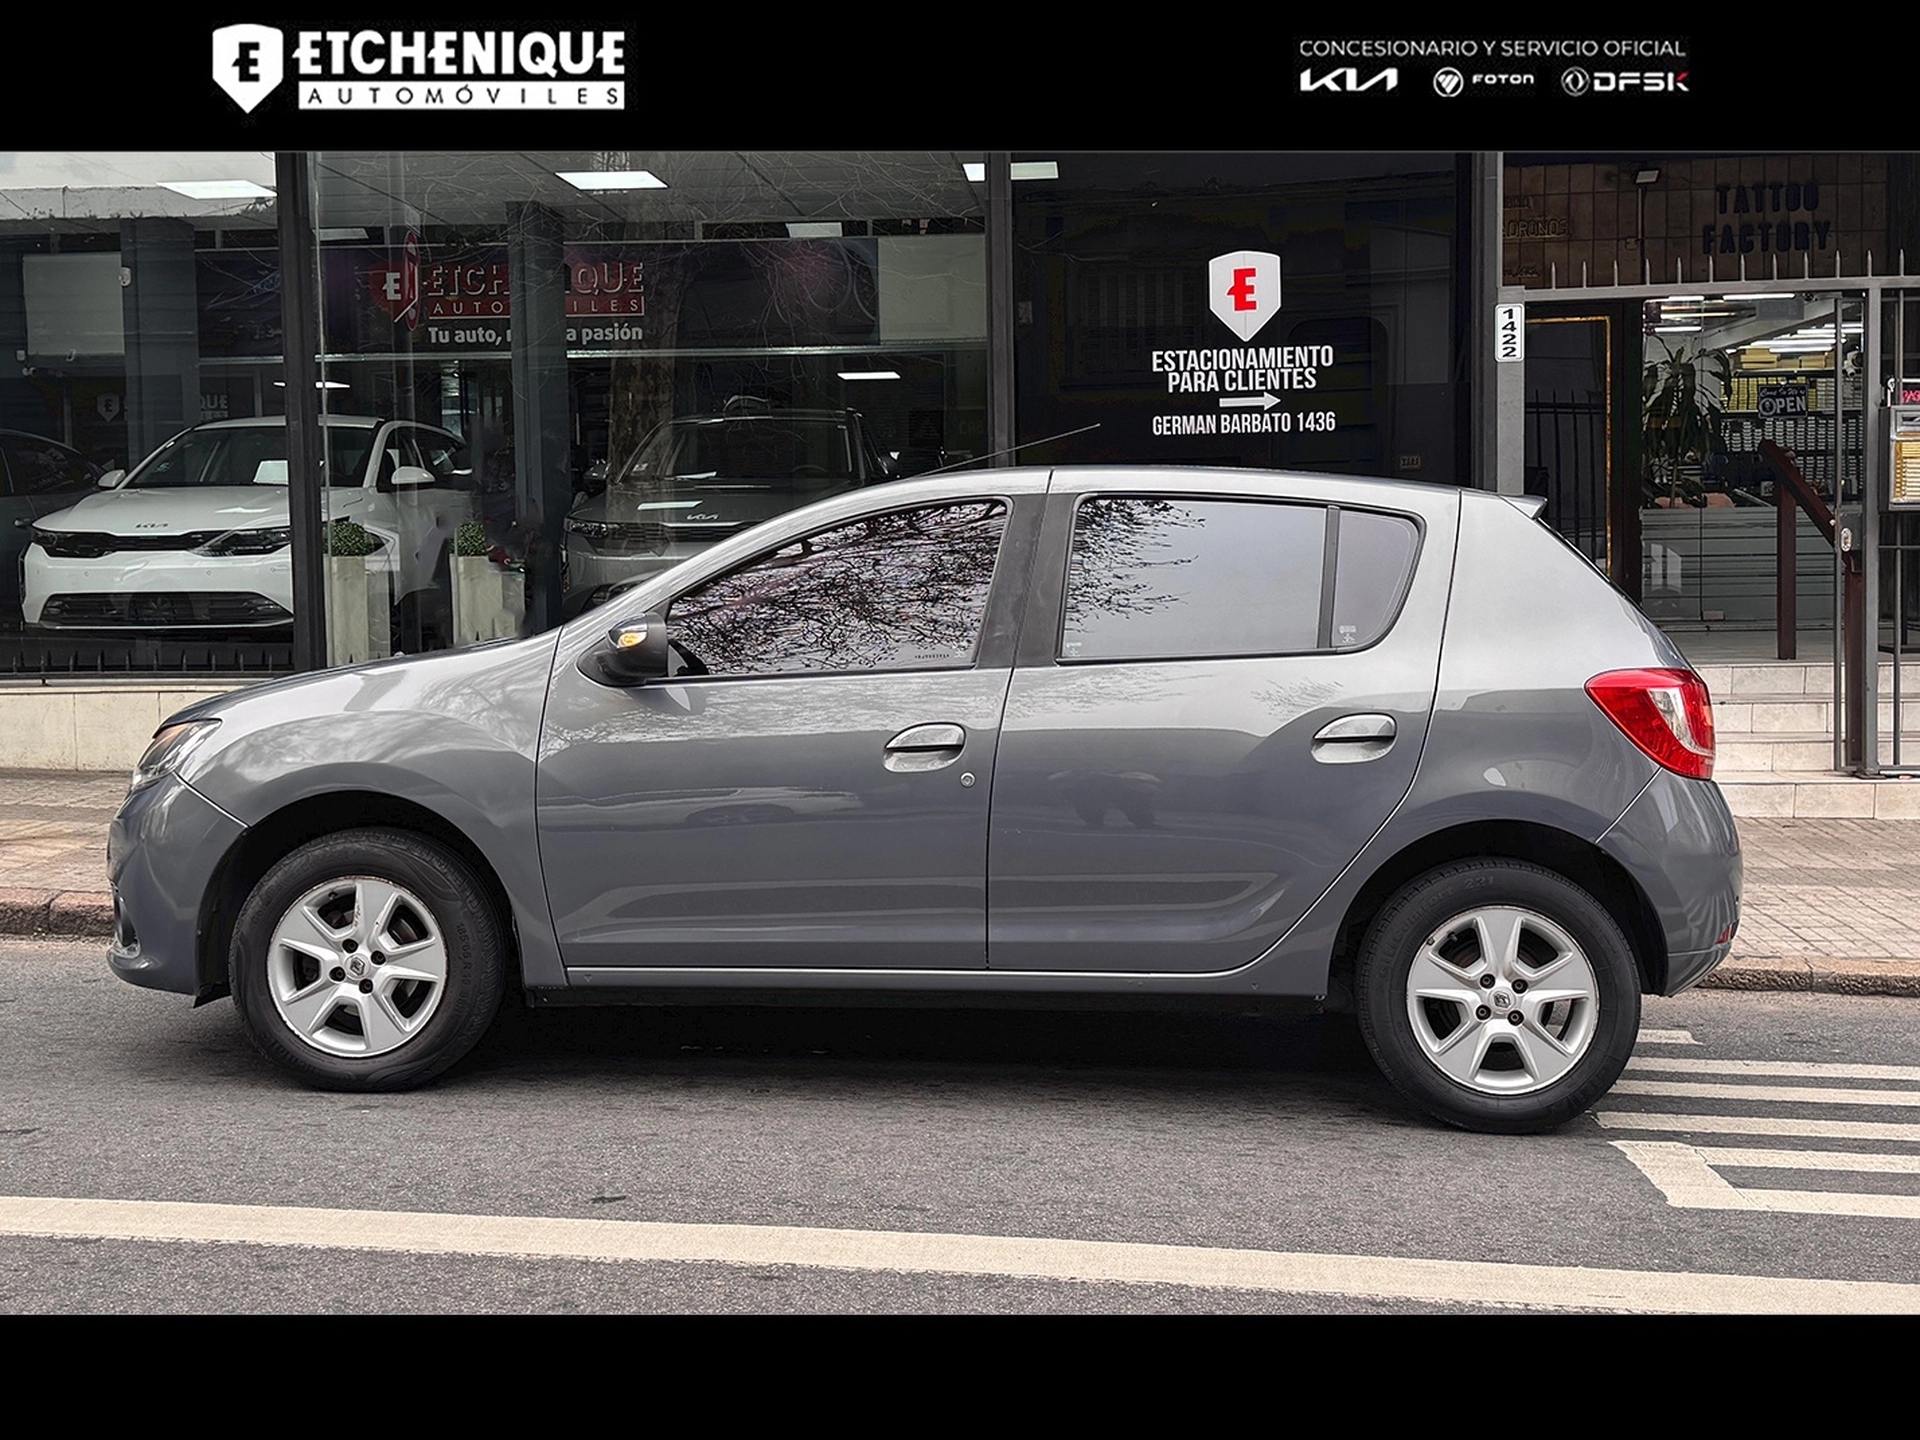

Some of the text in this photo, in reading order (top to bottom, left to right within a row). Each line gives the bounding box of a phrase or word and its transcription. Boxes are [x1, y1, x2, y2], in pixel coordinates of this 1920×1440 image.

[1716, 180, 1819, 214] TATTOO
[1702, 221, 1831, 255] FACTORY
[424, 261, 644, 296] ETCHIQUE
[433, 300, 638, 315] AUTOILES
[428, 327, 450, 343] Tu
[454, 327, 502, 345] auto,
[582, 323, 643, 345] pasión
[1502, 308, 1517, 358] 1422
[1152, 345, 1334, 372] ESTACIONAMIENTO
[1167, 367, 1317, 393] PARA CLIENTES
[1759, 395, 1807, 416] OPEN
[1152, 411, 1336, 436] GERMAN BARBATO 1436
